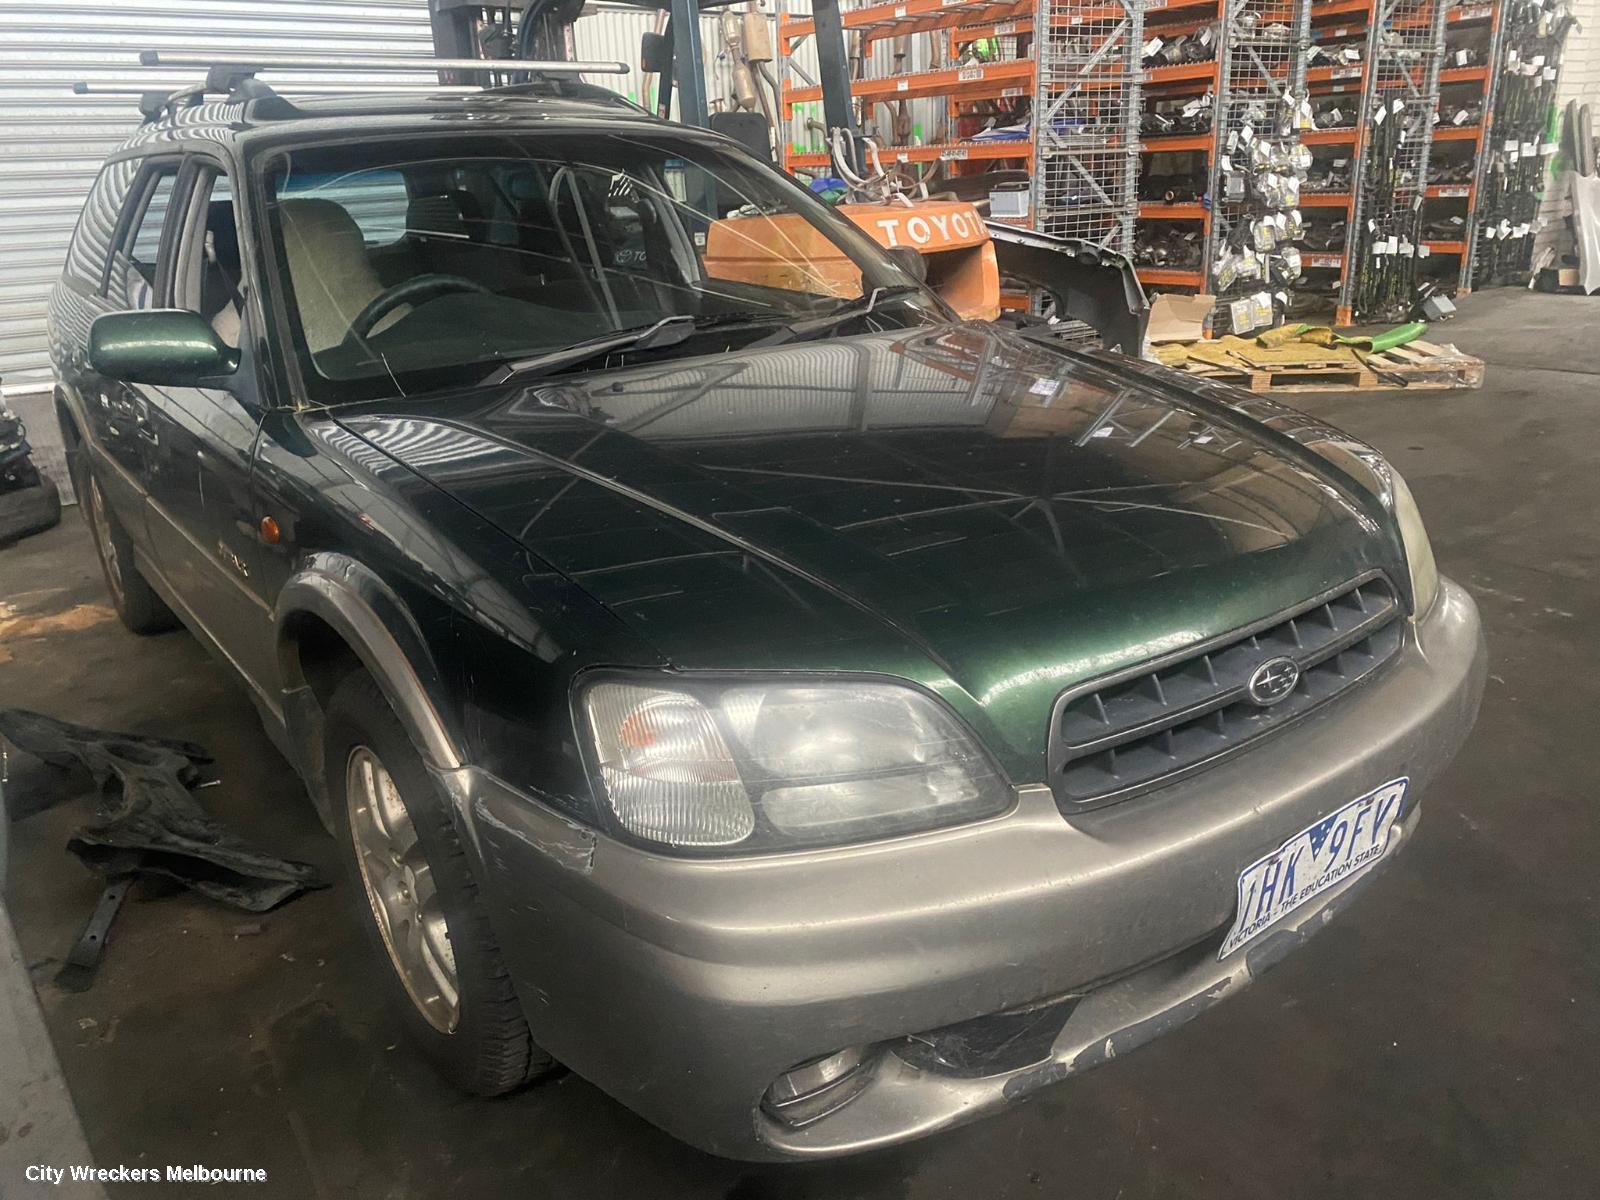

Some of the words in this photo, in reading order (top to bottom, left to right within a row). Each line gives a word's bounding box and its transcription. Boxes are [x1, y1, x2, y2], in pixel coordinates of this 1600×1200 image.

[876, 210, 988, 247] TOYOTA
[1229, 913, 1271, 949] VICTORIA
[1280, 893, 1298, 913] THE
[1299, 859, 1353, 901] EDUCATION
[1353, 843, 1380, 867] STATE
[1239, 845, 1305, 932] 1HK
